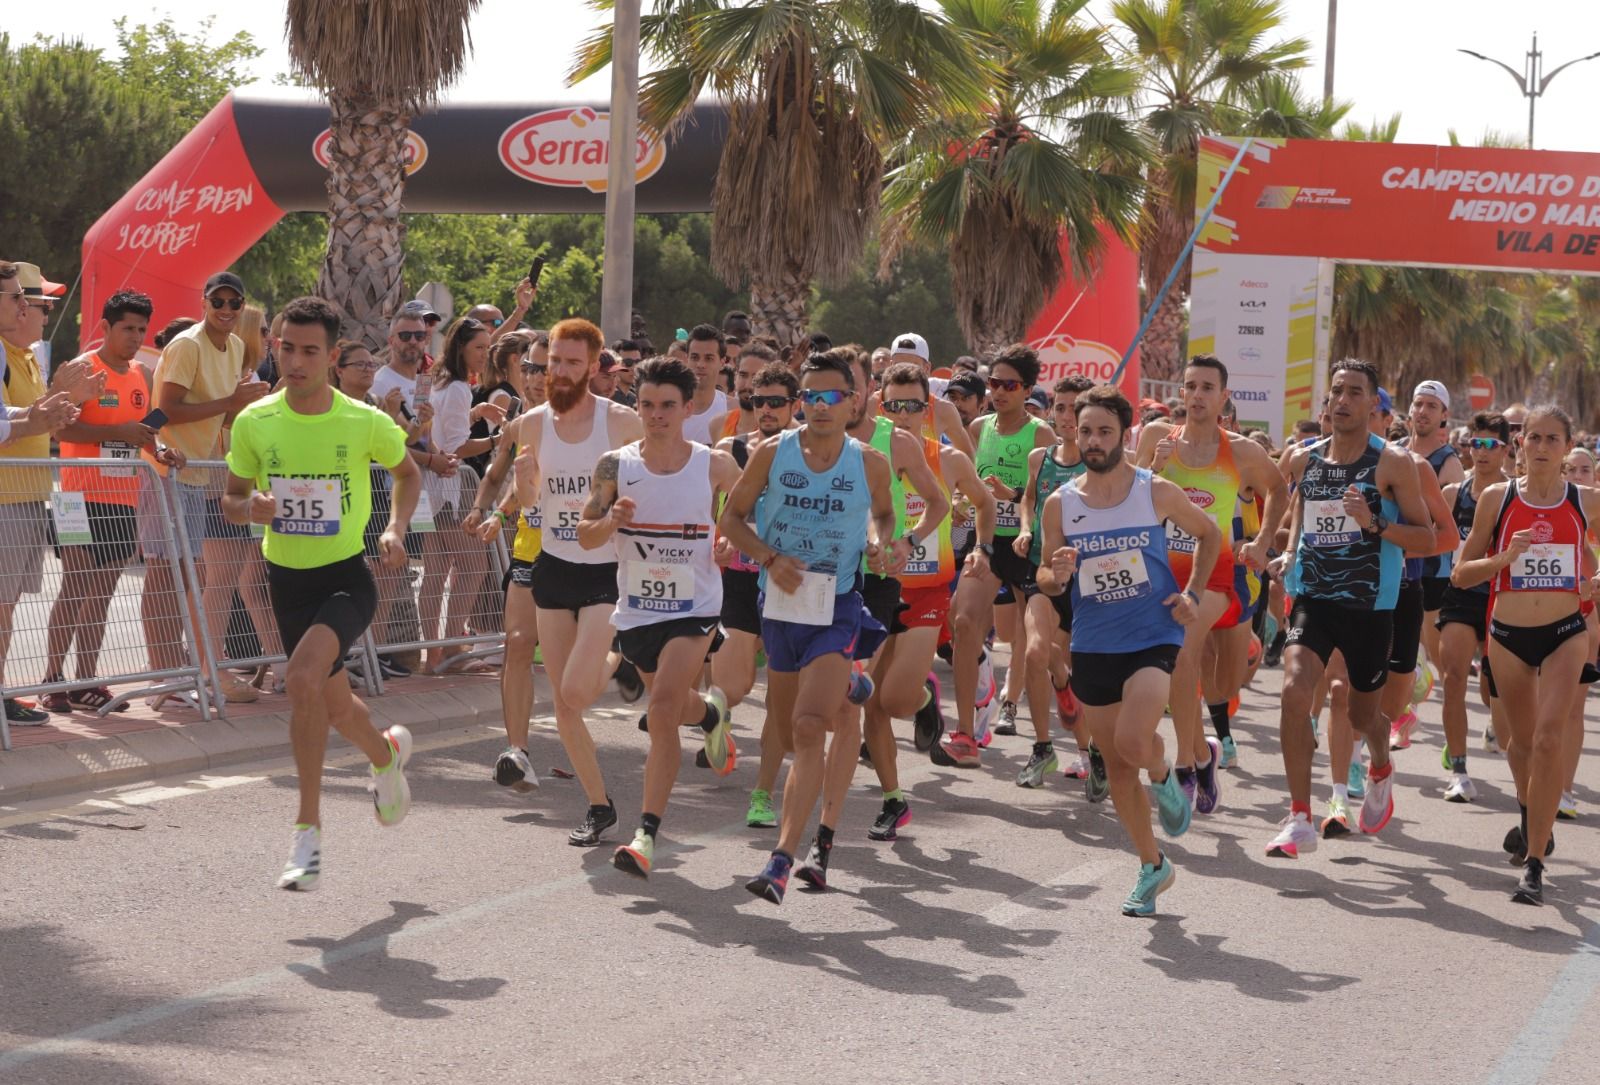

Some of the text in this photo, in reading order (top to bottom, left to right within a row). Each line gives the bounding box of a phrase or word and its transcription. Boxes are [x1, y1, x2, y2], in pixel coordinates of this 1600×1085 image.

[518, 130, 650, 166] Serrao
[1382, 167, 1600, 198] CAMPEONATO D
[135, 180, 253, 218] COME BIEN
[1448, 199, 1537, 224] MEDIO
[129, 222, 201, 255] CORRE!
[1496, 230, 1600, 256] VILA DE
[1240, 280, 1269, 288] Adecco
[1037, 361, 1115, 382] errano
[1230, 390, 1268, 401] oma
[781, 473, 809, 488] TROPS
[282, 499, 324, 519] 515
[784, 494, 845, 515] nerja
[997, 502, 1016, 516] 54
[279, 521, 326, 534] Joma
[558, 512, 580, 527] 55
[1316, 516, 1346, 533] 587
[1167, 540, 1194, 550] Jom
[1313, 533, 1351, 545] Joma
[658, 548, 694, 557] VICKY
[1525, 559, 1562, 575] 566
[641, 580, 677, 598] 591
[1094, 569, 1133, 592] 558
[1522, 577, 1563, 589] Joma
